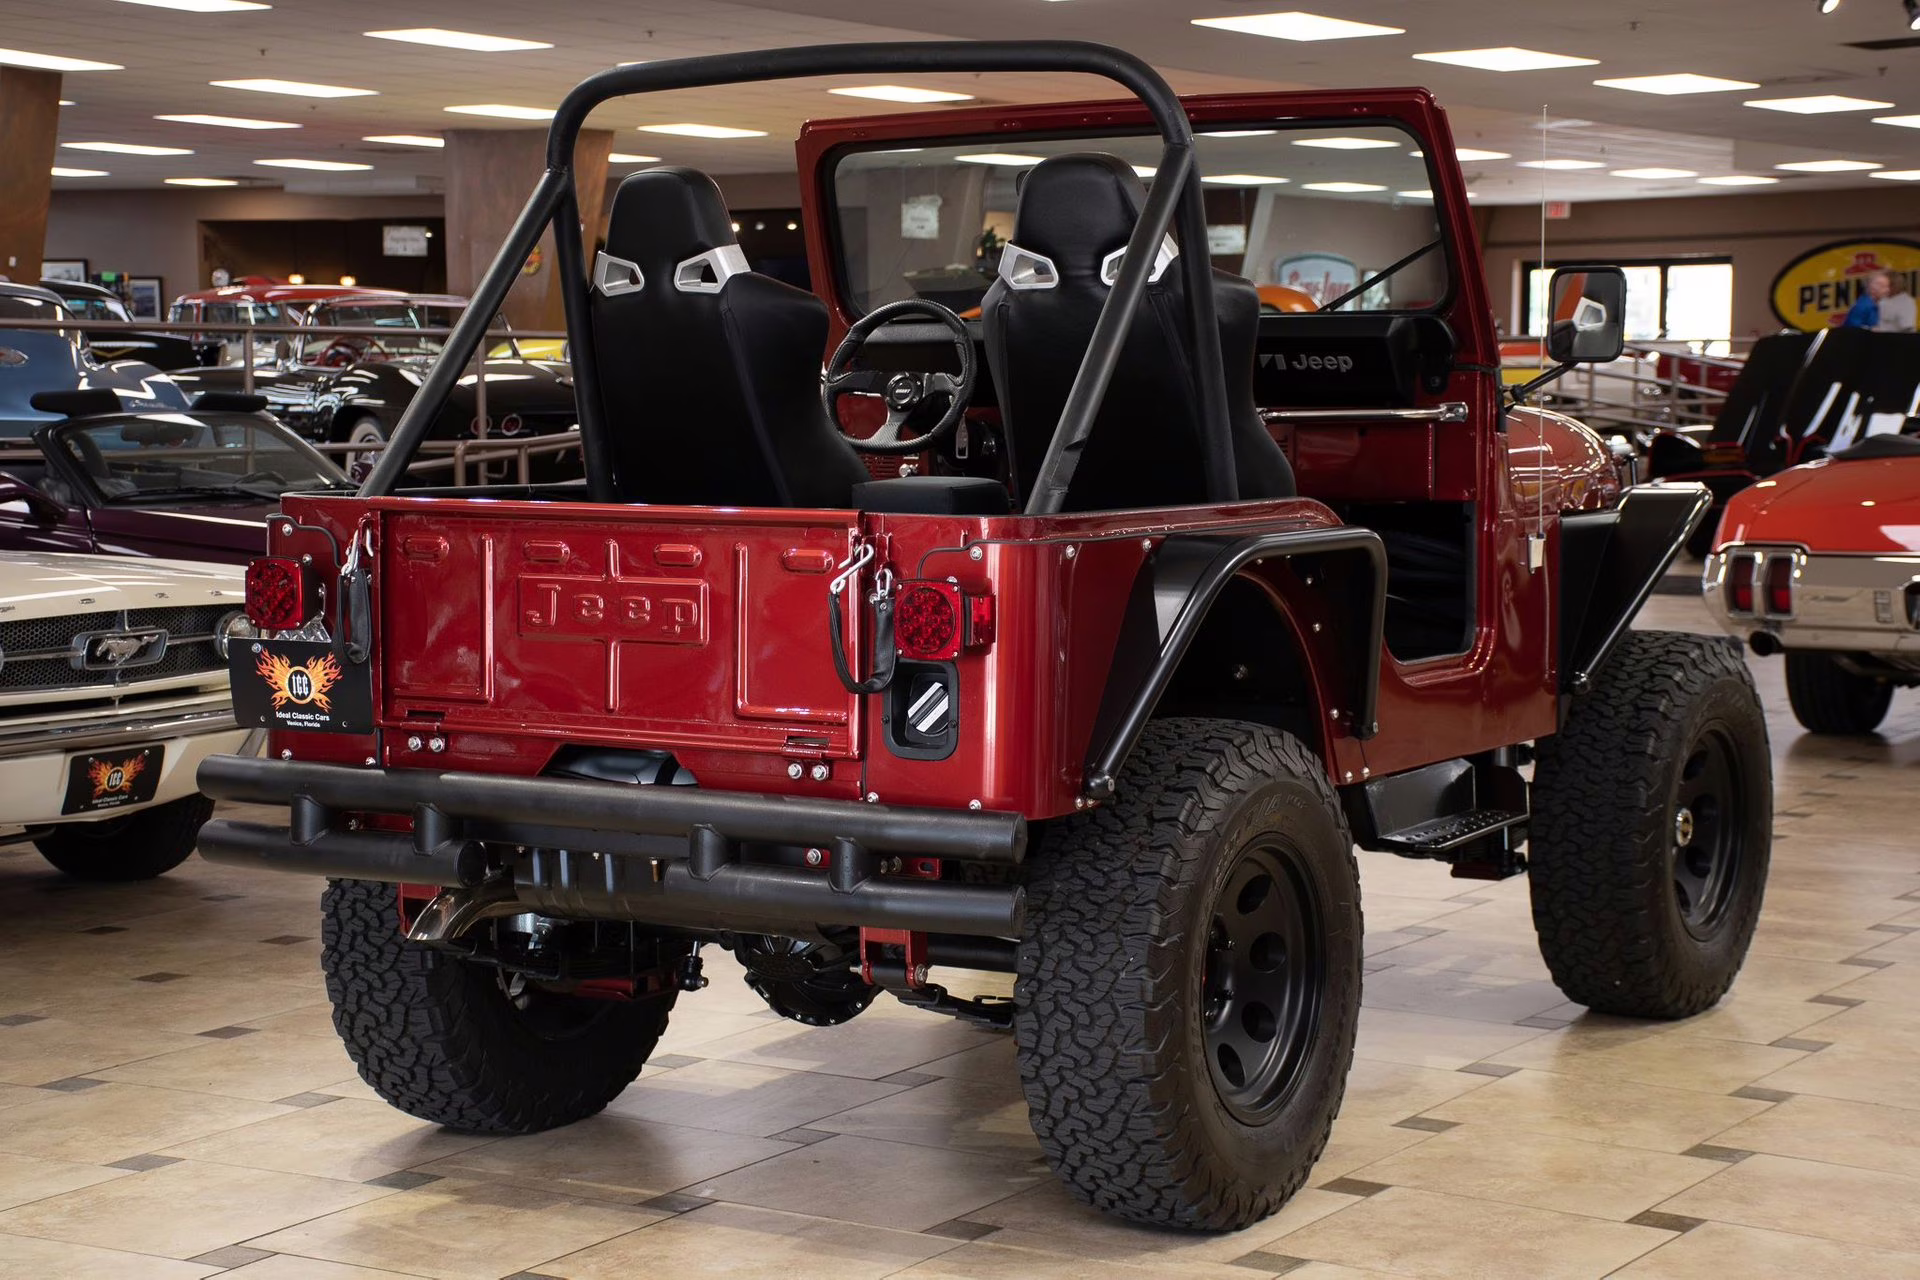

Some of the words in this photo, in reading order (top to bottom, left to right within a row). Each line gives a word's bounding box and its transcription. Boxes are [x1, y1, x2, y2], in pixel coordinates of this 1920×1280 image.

[1292, 354, 1353, 373] Jeep
[526, 584, 698, 635] Jeep
[276, 711, 291, 719] Ideal
[292, 712, 314, 720] Classic
[315, 713, 330, 721] Cars
